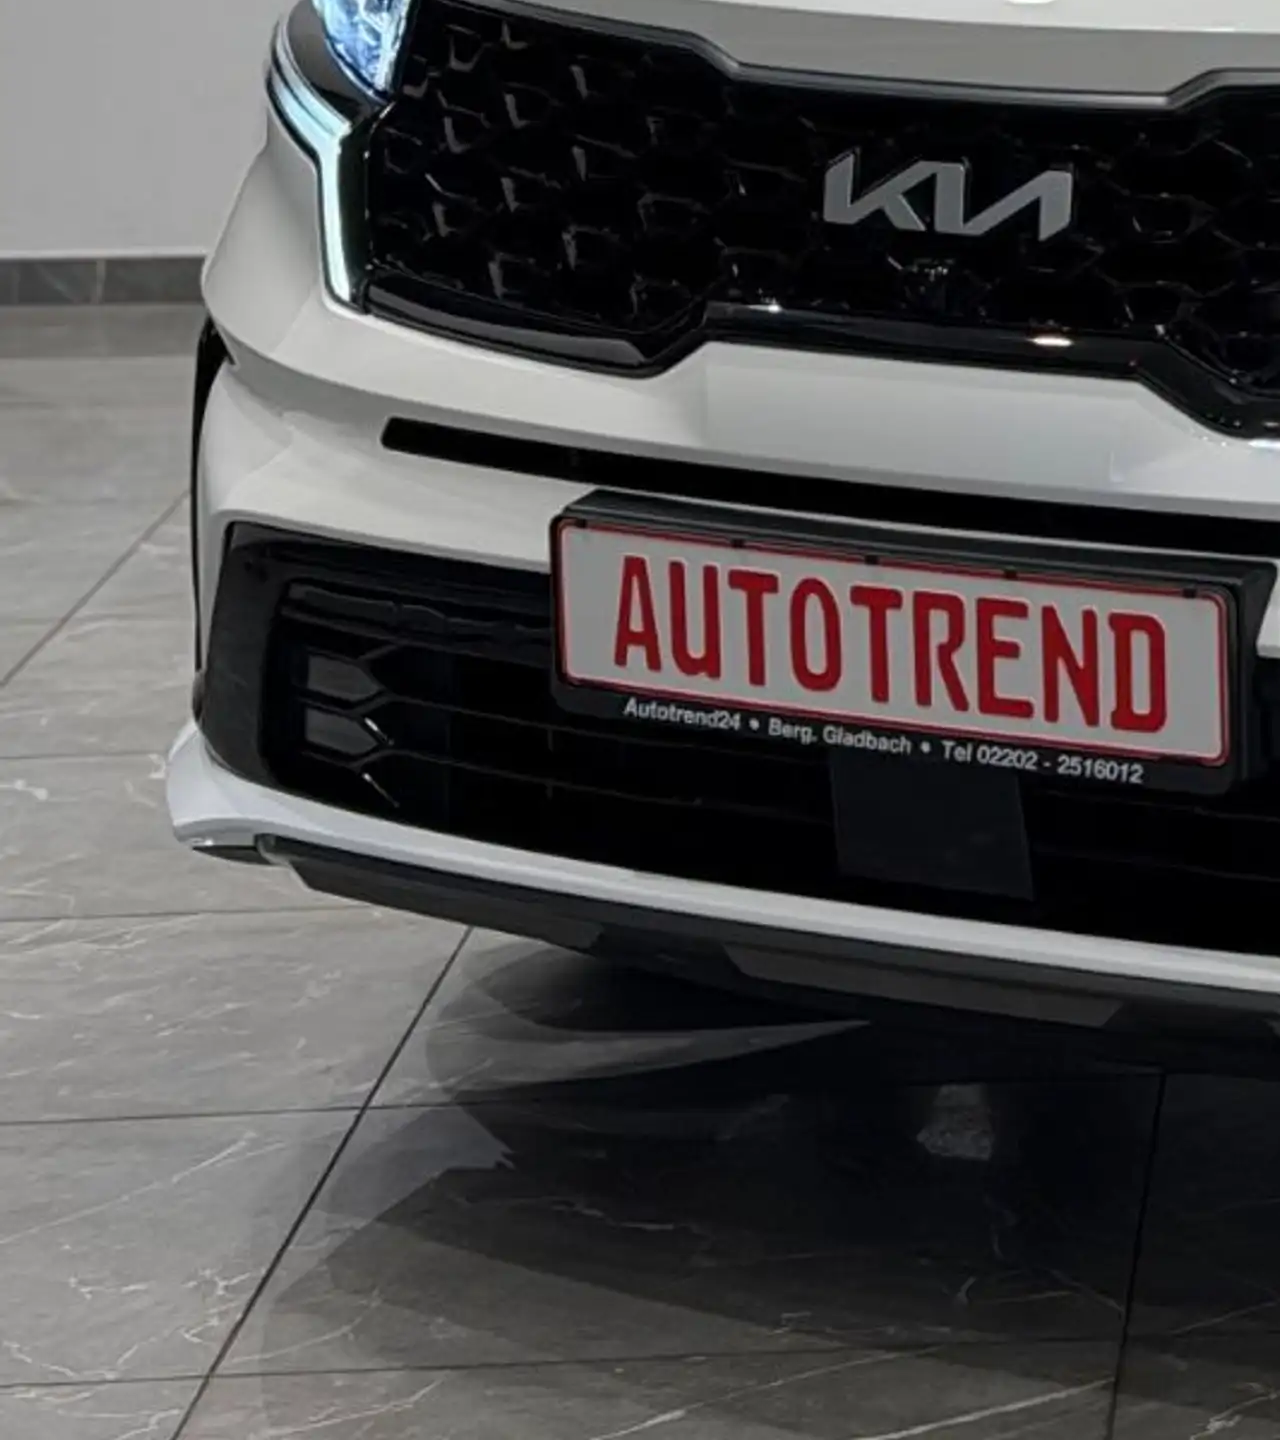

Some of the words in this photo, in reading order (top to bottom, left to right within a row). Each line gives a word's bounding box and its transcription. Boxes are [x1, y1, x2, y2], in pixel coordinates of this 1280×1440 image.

[823, 152, 1073, 243] KIA
[613, 555, 1167, 734] AUTOTREND
[623, 696, 741, 731] Autotrend24
[768, 717, 818, 745] Berg.
[823, 725, 912, 755] Gladbach
[941, 740, 973, 765] Tel
[976, 745, 1039, 771] 02202
[1057, 754, 1145, 785] 2516012
